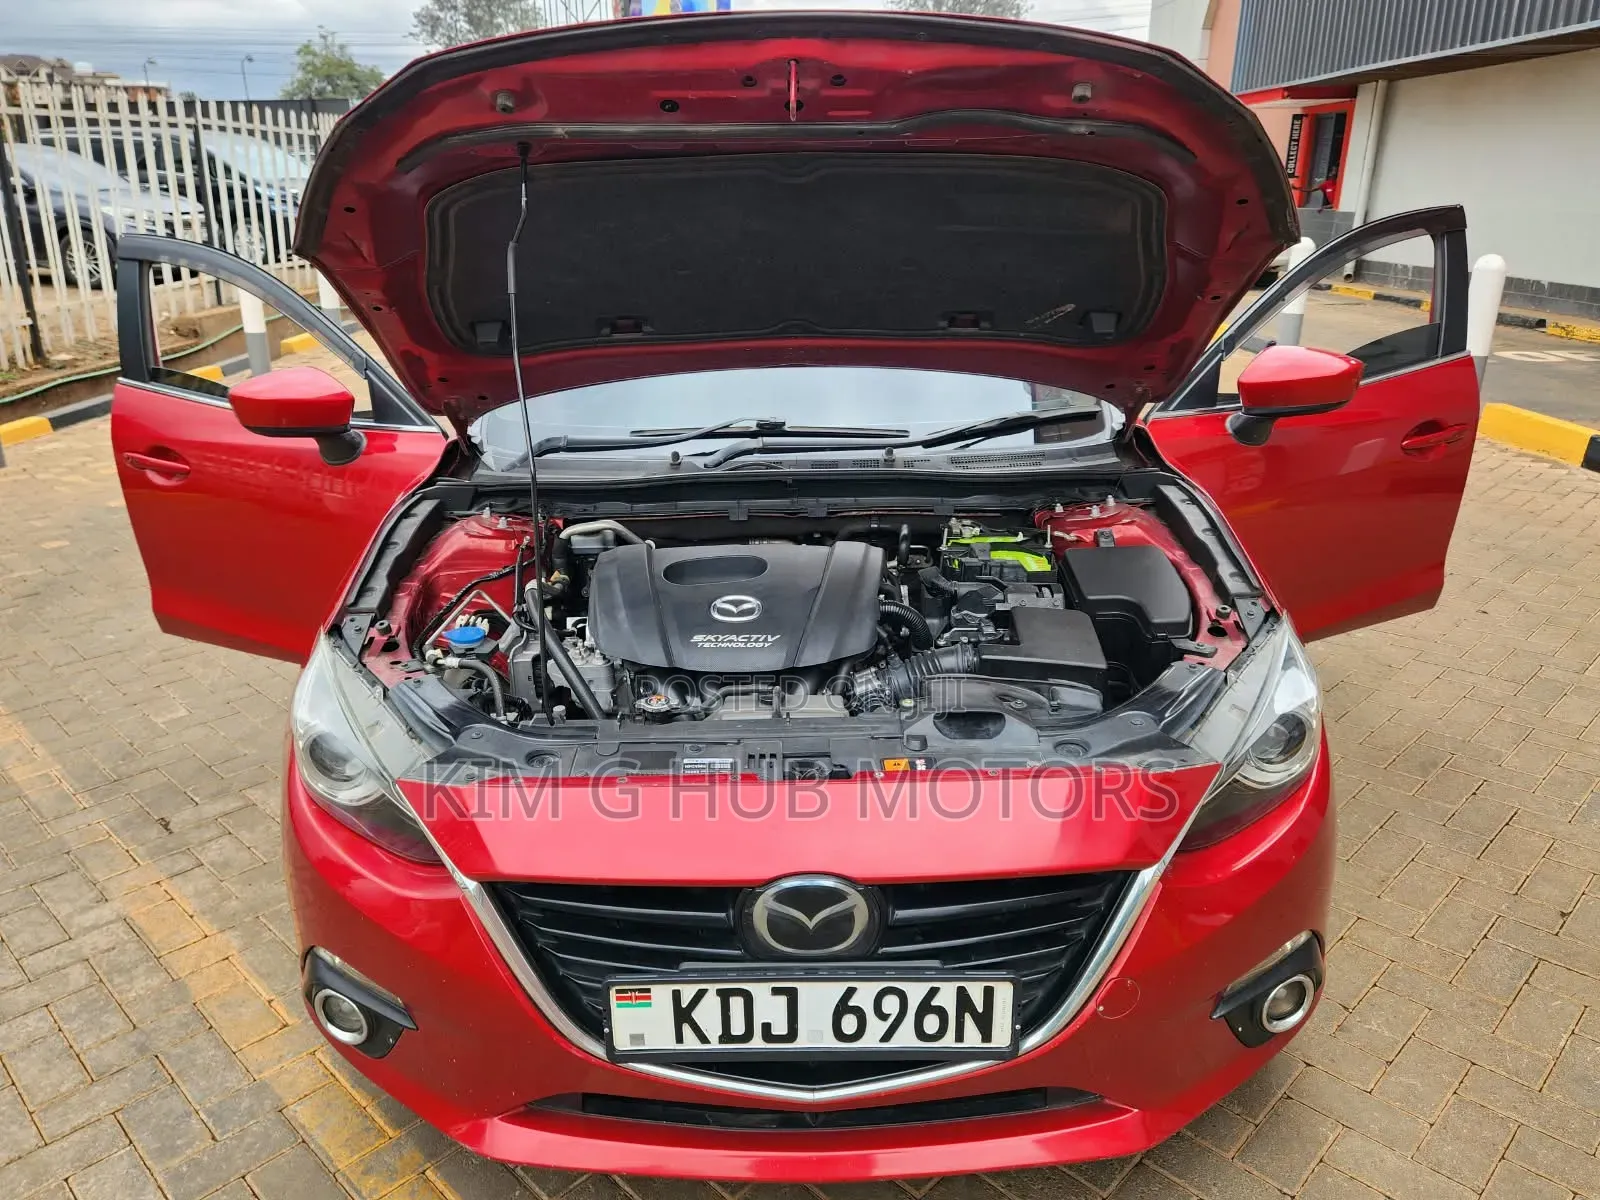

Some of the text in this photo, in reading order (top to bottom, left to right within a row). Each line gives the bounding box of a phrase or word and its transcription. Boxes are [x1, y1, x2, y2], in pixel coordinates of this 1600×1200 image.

[1287, 119, 1302, 174] COLLECT HERE
[690, 634, 781, 642] SKYACTIV
[671, 986, 799, 1045] KDJ
[831, 985, 995, 1043] 696N
